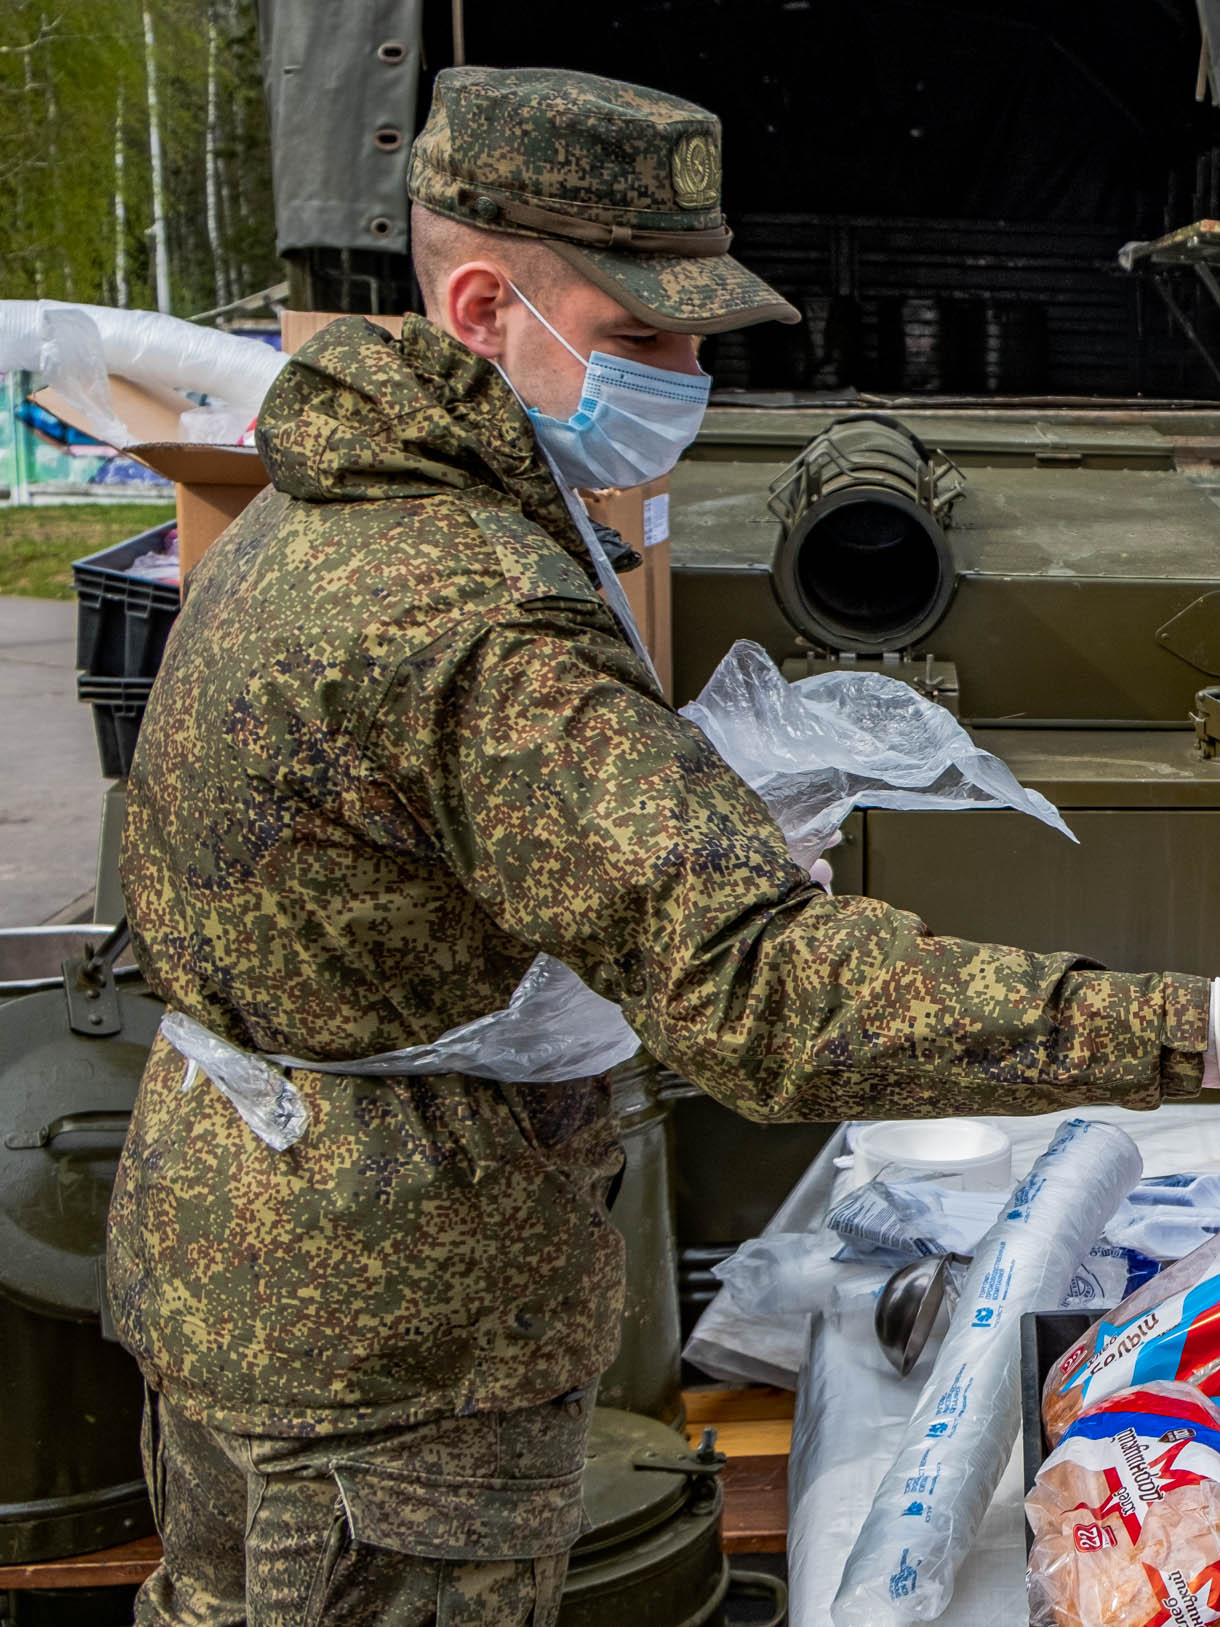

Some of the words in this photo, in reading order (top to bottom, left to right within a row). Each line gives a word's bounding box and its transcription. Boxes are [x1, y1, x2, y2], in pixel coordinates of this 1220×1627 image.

[1111, 1427, 1164, 1501] Дарницкий
[1114, 1486, 1136, 1516] хлеб
[1077, 1526, 1101, 1548] 22
